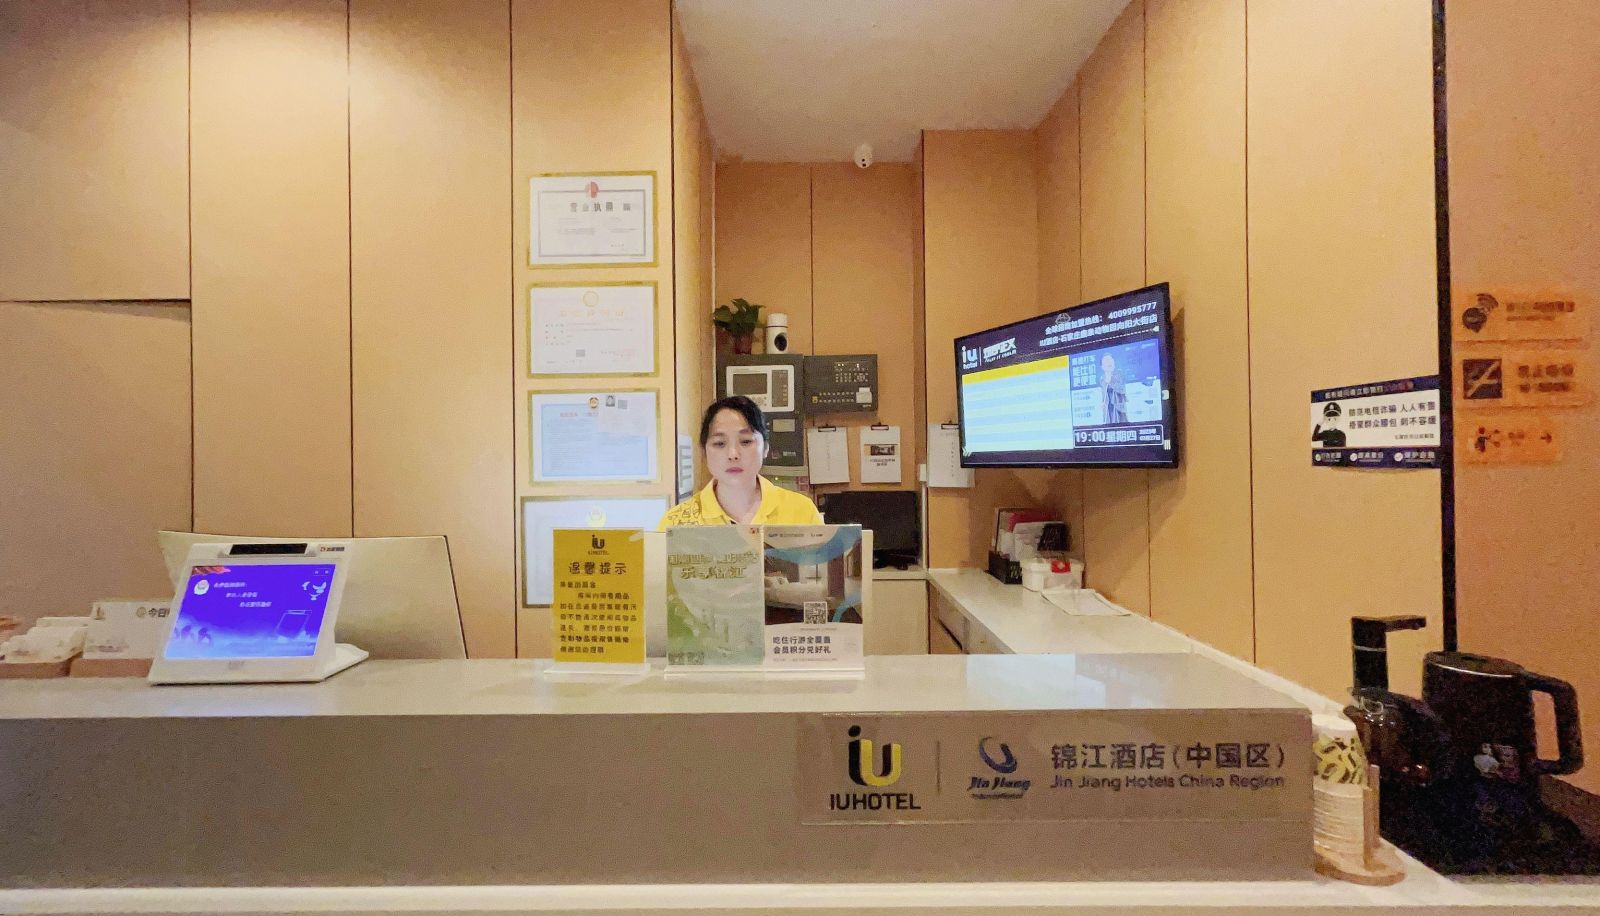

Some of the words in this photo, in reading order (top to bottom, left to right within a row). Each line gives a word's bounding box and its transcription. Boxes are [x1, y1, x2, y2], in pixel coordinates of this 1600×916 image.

[1108, 302, 1157, 319] 4009995777
[1400, 415, 1437, 427] 刻不容缓
[1075, 430, 1105, 443] 19:00
[1106, 430, 1137, 443] 星期四
[568, 562, 627, 575] 温馨提示
[148, 607, 171, 618] 今日
[772, 635, 831, 645] 吃住行游全覆盖
[773, 645, 832, 655] 会员积分兑好礼
[967, 777, 990, 791] Jin
[992, 777, 1031, 791] Jiang
[1050, 774, 1073, 789] Jin
[1078, 774, 1122, 790] Jiang
[1125, 774, 1175, 788] Hotels
[1179, 773, 1225, 788] China
[1229, 773, 1285, 790] Region
